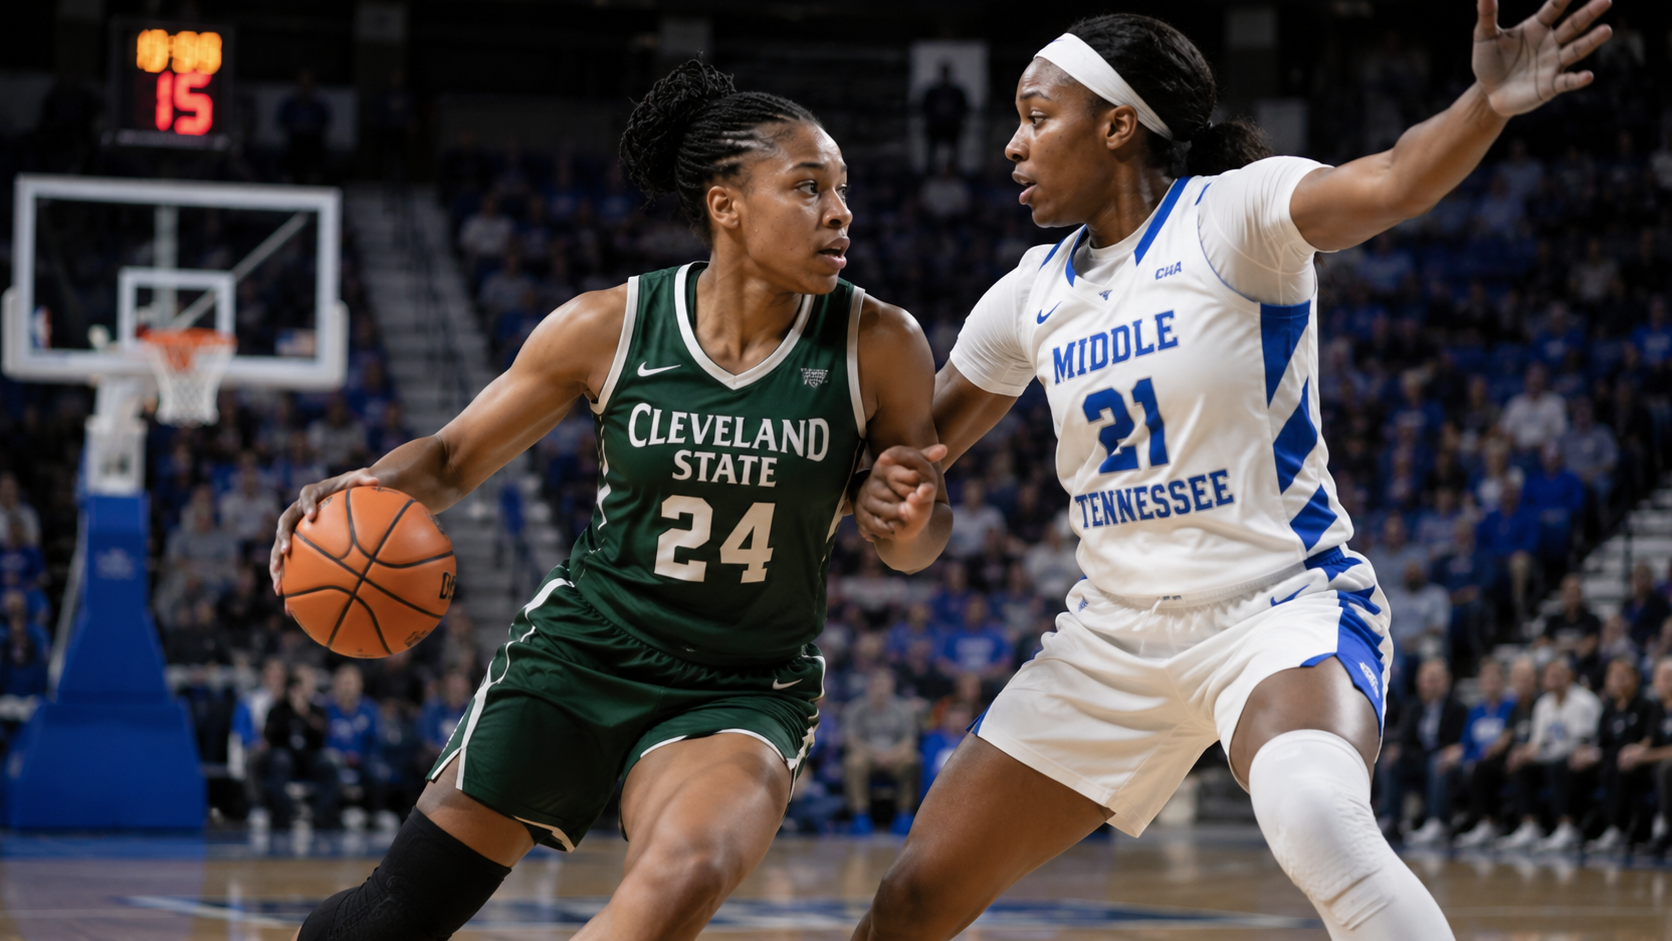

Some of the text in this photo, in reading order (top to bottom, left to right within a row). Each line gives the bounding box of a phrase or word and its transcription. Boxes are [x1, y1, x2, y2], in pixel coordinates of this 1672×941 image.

[155, 70, 213, 136] 15
[1052, 310, 1179, 386] MIDDLE
[628, 403, 829, 462] CLEVELAND
[1082, 376, 1169, 474] 21
[672, 449, 778, 487] STATE
[1074, 469, 1235, 529] TENNESSEE
[653, 494, 776, 584] 24
